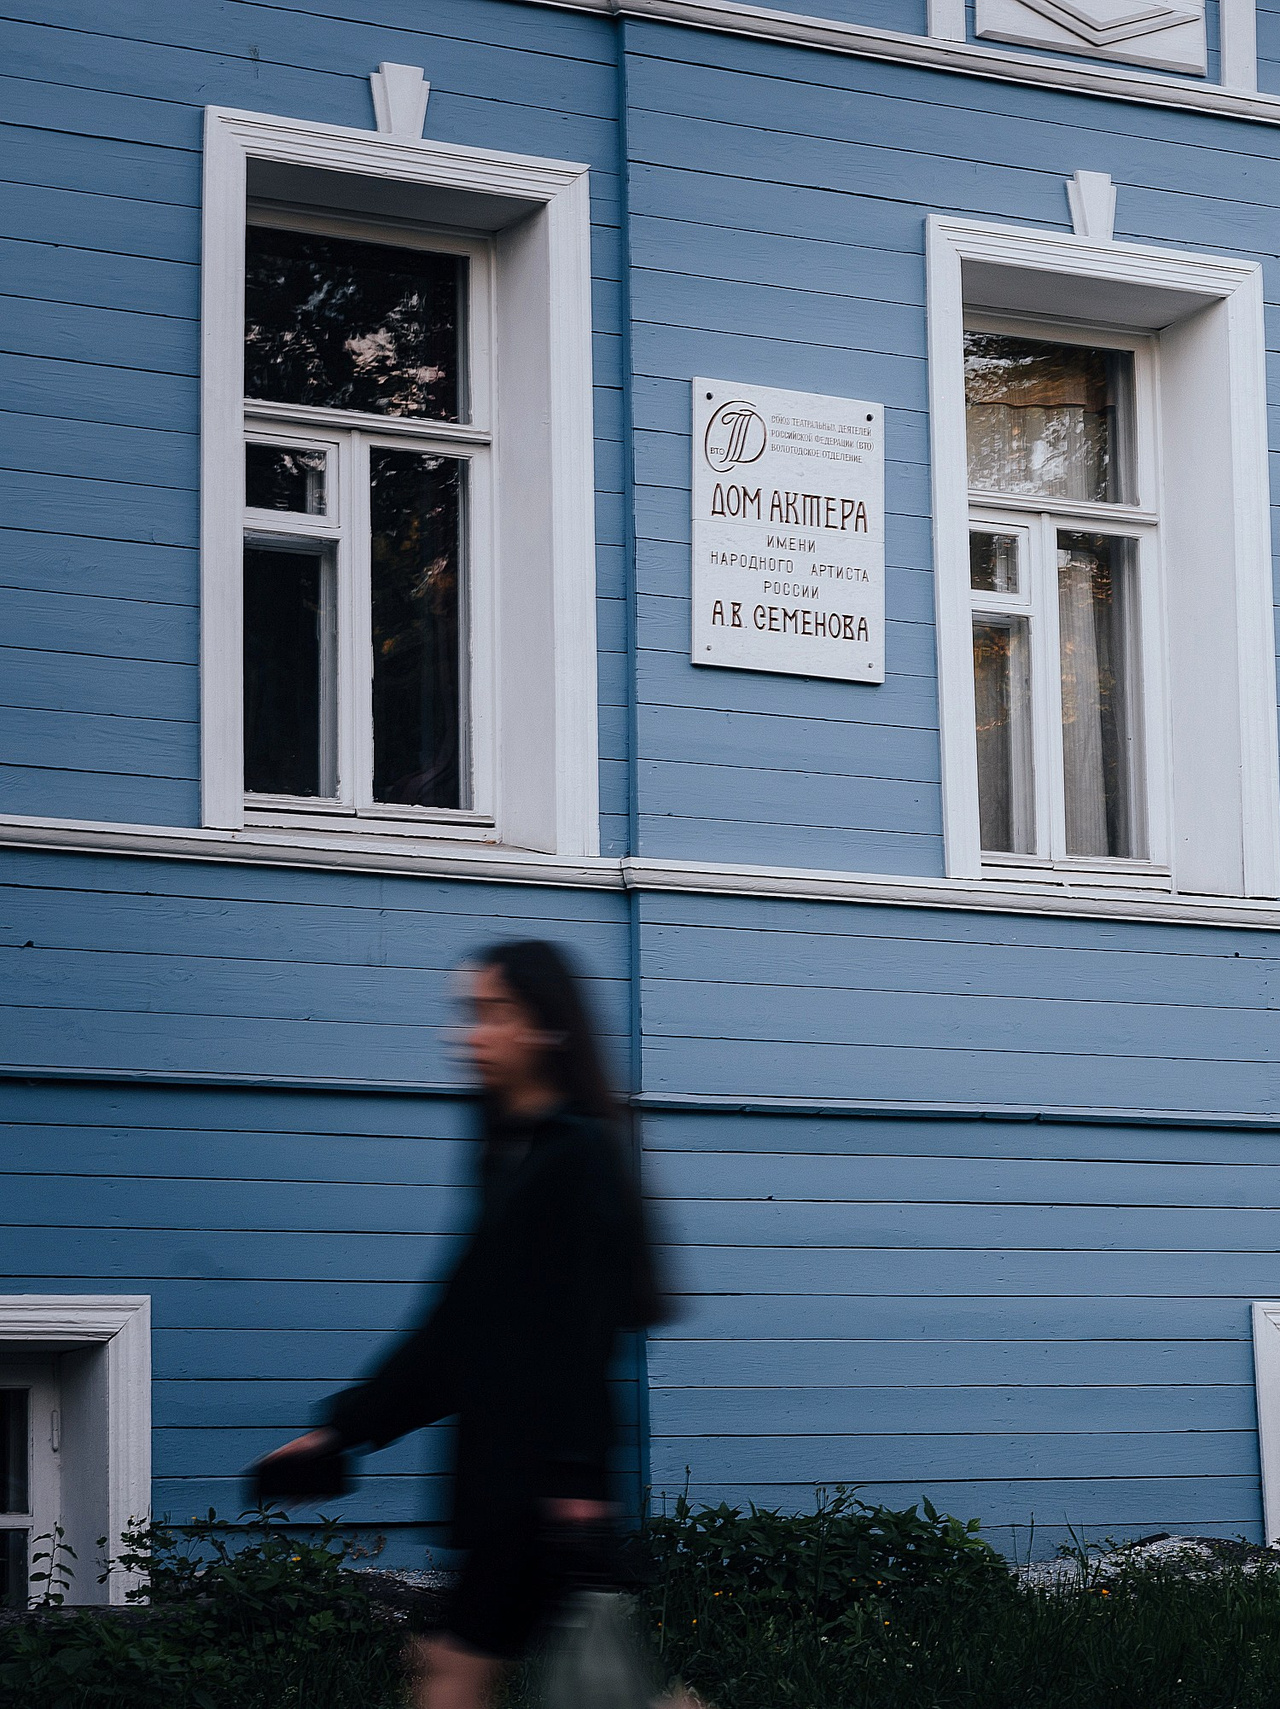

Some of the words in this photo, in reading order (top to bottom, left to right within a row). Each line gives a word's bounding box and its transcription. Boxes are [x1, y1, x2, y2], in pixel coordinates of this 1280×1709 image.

[771, 415, 790, 425] СОЮЗ
[792, 417, 837, 431] ТЕАТРАЛЬНЫХ
[838, 423, 872, 437] ДЕЯТЕЛЕЙ
[710, 447, 725, 455] ВТО
[771, 429, 813, 443] РОССИЙСКОЙ
[814, 435, 854, 449] ФЕДЕРАЦИИ
[856, 441, 875, 452] (ВТО)
[771, 443, 820, 457] ВОЛОГОДСКОЕ
[822, 450, 863, 464] ОТДЕЛЕНИЕ
[711, 483, 762, 520] ДОМ
[770, 490, 868, 533] АКТЕРА
[767, 535, 816, 553] ИМЕНИ
[711, 551, 794, 574] НАРОДНОГО
[811, 563, 870, 582] АРТИСТА
[764, 581, 819, 600] РОССИИ
[753, 604, 869, 642] СЕМЕНОВА
